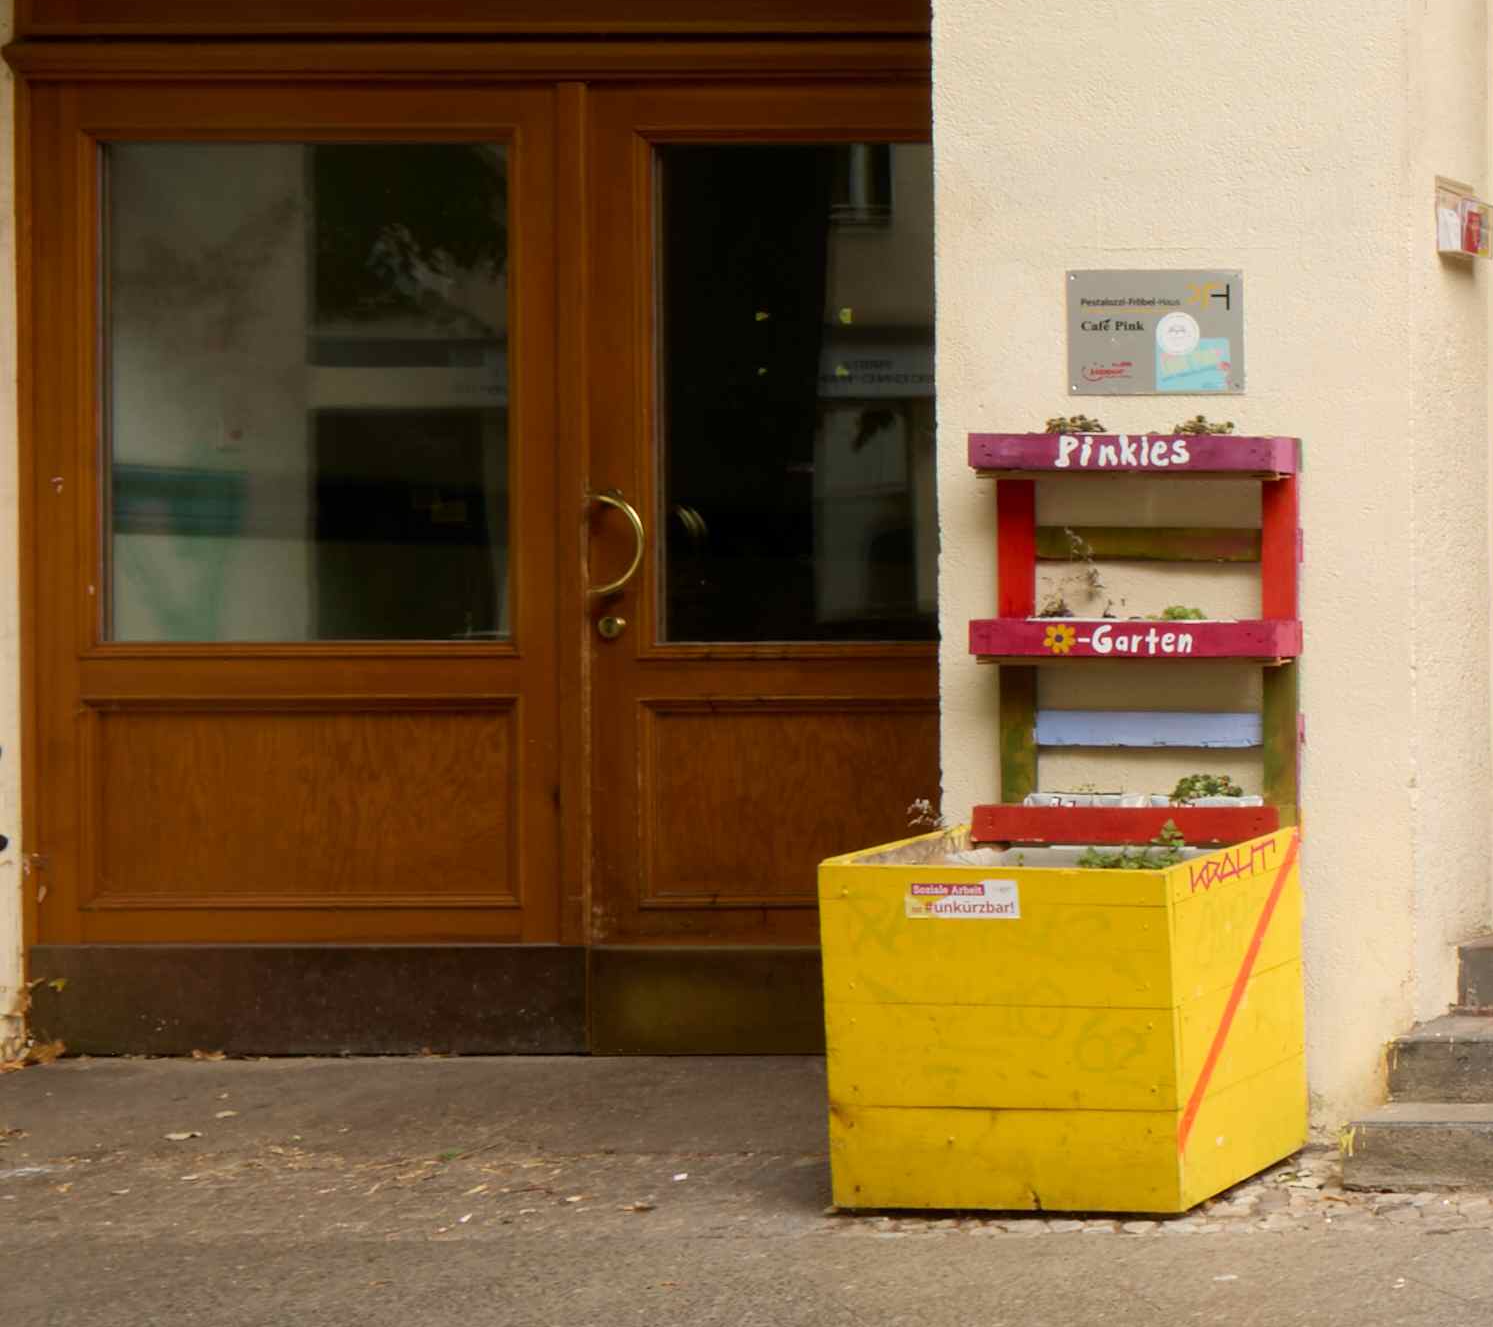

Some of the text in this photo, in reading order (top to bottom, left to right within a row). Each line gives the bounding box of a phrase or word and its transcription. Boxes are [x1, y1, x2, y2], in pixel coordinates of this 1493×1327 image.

[1080, 318, 1145, 332] Café Pink
[1055, 434, 1191, 468] Pinkies
[912, 884, 984, 896] Soziale Arbeit
